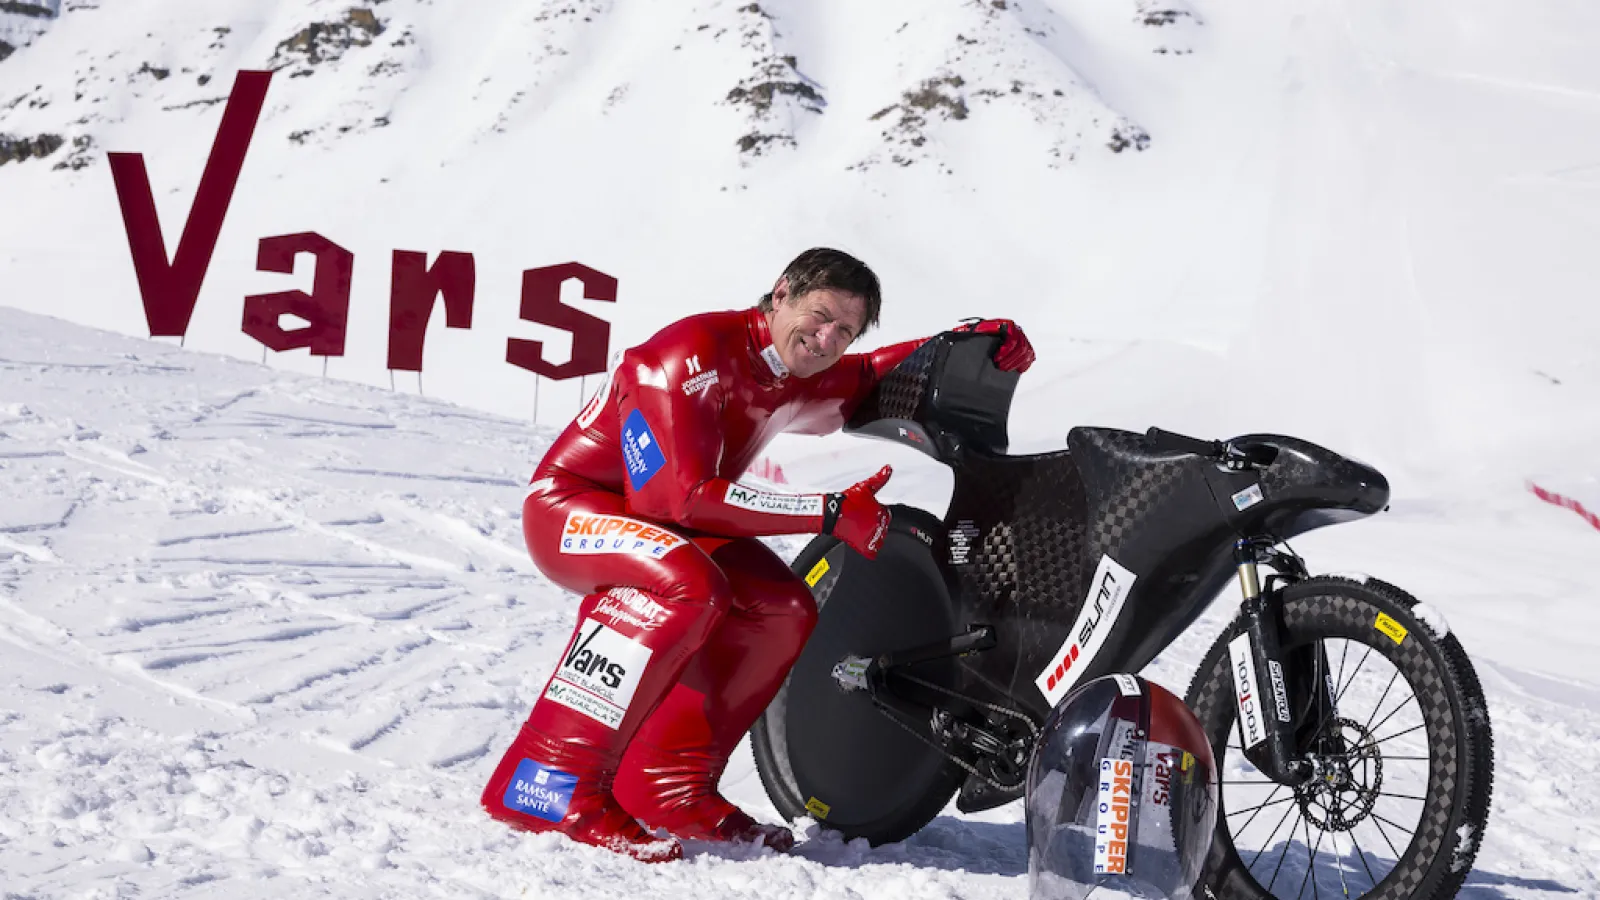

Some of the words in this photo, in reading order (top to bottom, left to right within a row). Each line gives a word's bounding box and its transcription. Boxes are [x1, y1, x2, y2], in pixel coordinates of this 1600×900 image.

[107, 70, 618, 380] Vars
[563, 538, 666, 556] GROUPE
[566, 515, 680, 547] SKIPPER
[564, 624, 627, 689] Vars
[1237, 652, 1259, 743] ROCTOOL
[515, 779, 563, 804] RAMSAY
[516, 794, 550, 814] SANTÉ
[1096, 760, 1111, 873] GROUPE
[1107, 761, 1132, 874] SKIPPER
